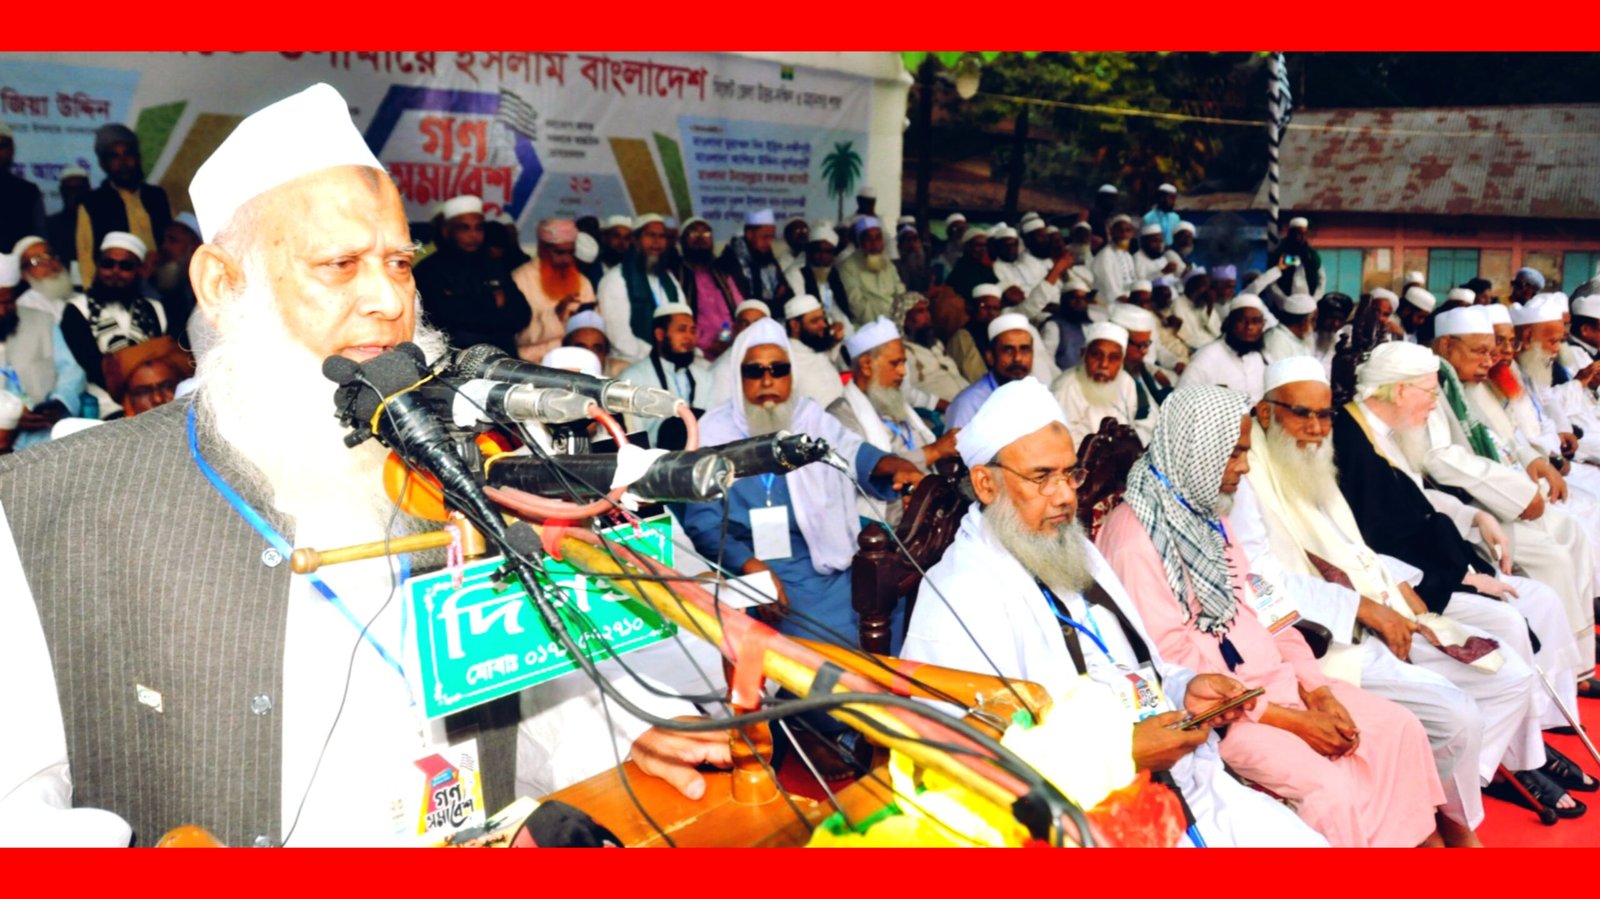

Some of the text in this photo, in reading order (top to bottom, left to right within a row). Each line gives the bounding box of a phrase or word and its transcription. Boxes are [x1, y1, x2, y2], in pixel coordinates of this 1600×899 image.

[455, 52, 568, 86] ইসলাম
[577, 54, 708, 101] বাংলাদেশ
[0, 86, 111, 119] জিয়া উদ্দিন
[419, 115, 488, 164] গণ
[390, 153, 513, 216] সমাবেশ
[569, 176, 592, 193] ২৩
[435, 784, 462, 806] গণ
[427, 799, 474, 828] সমাবেশ
